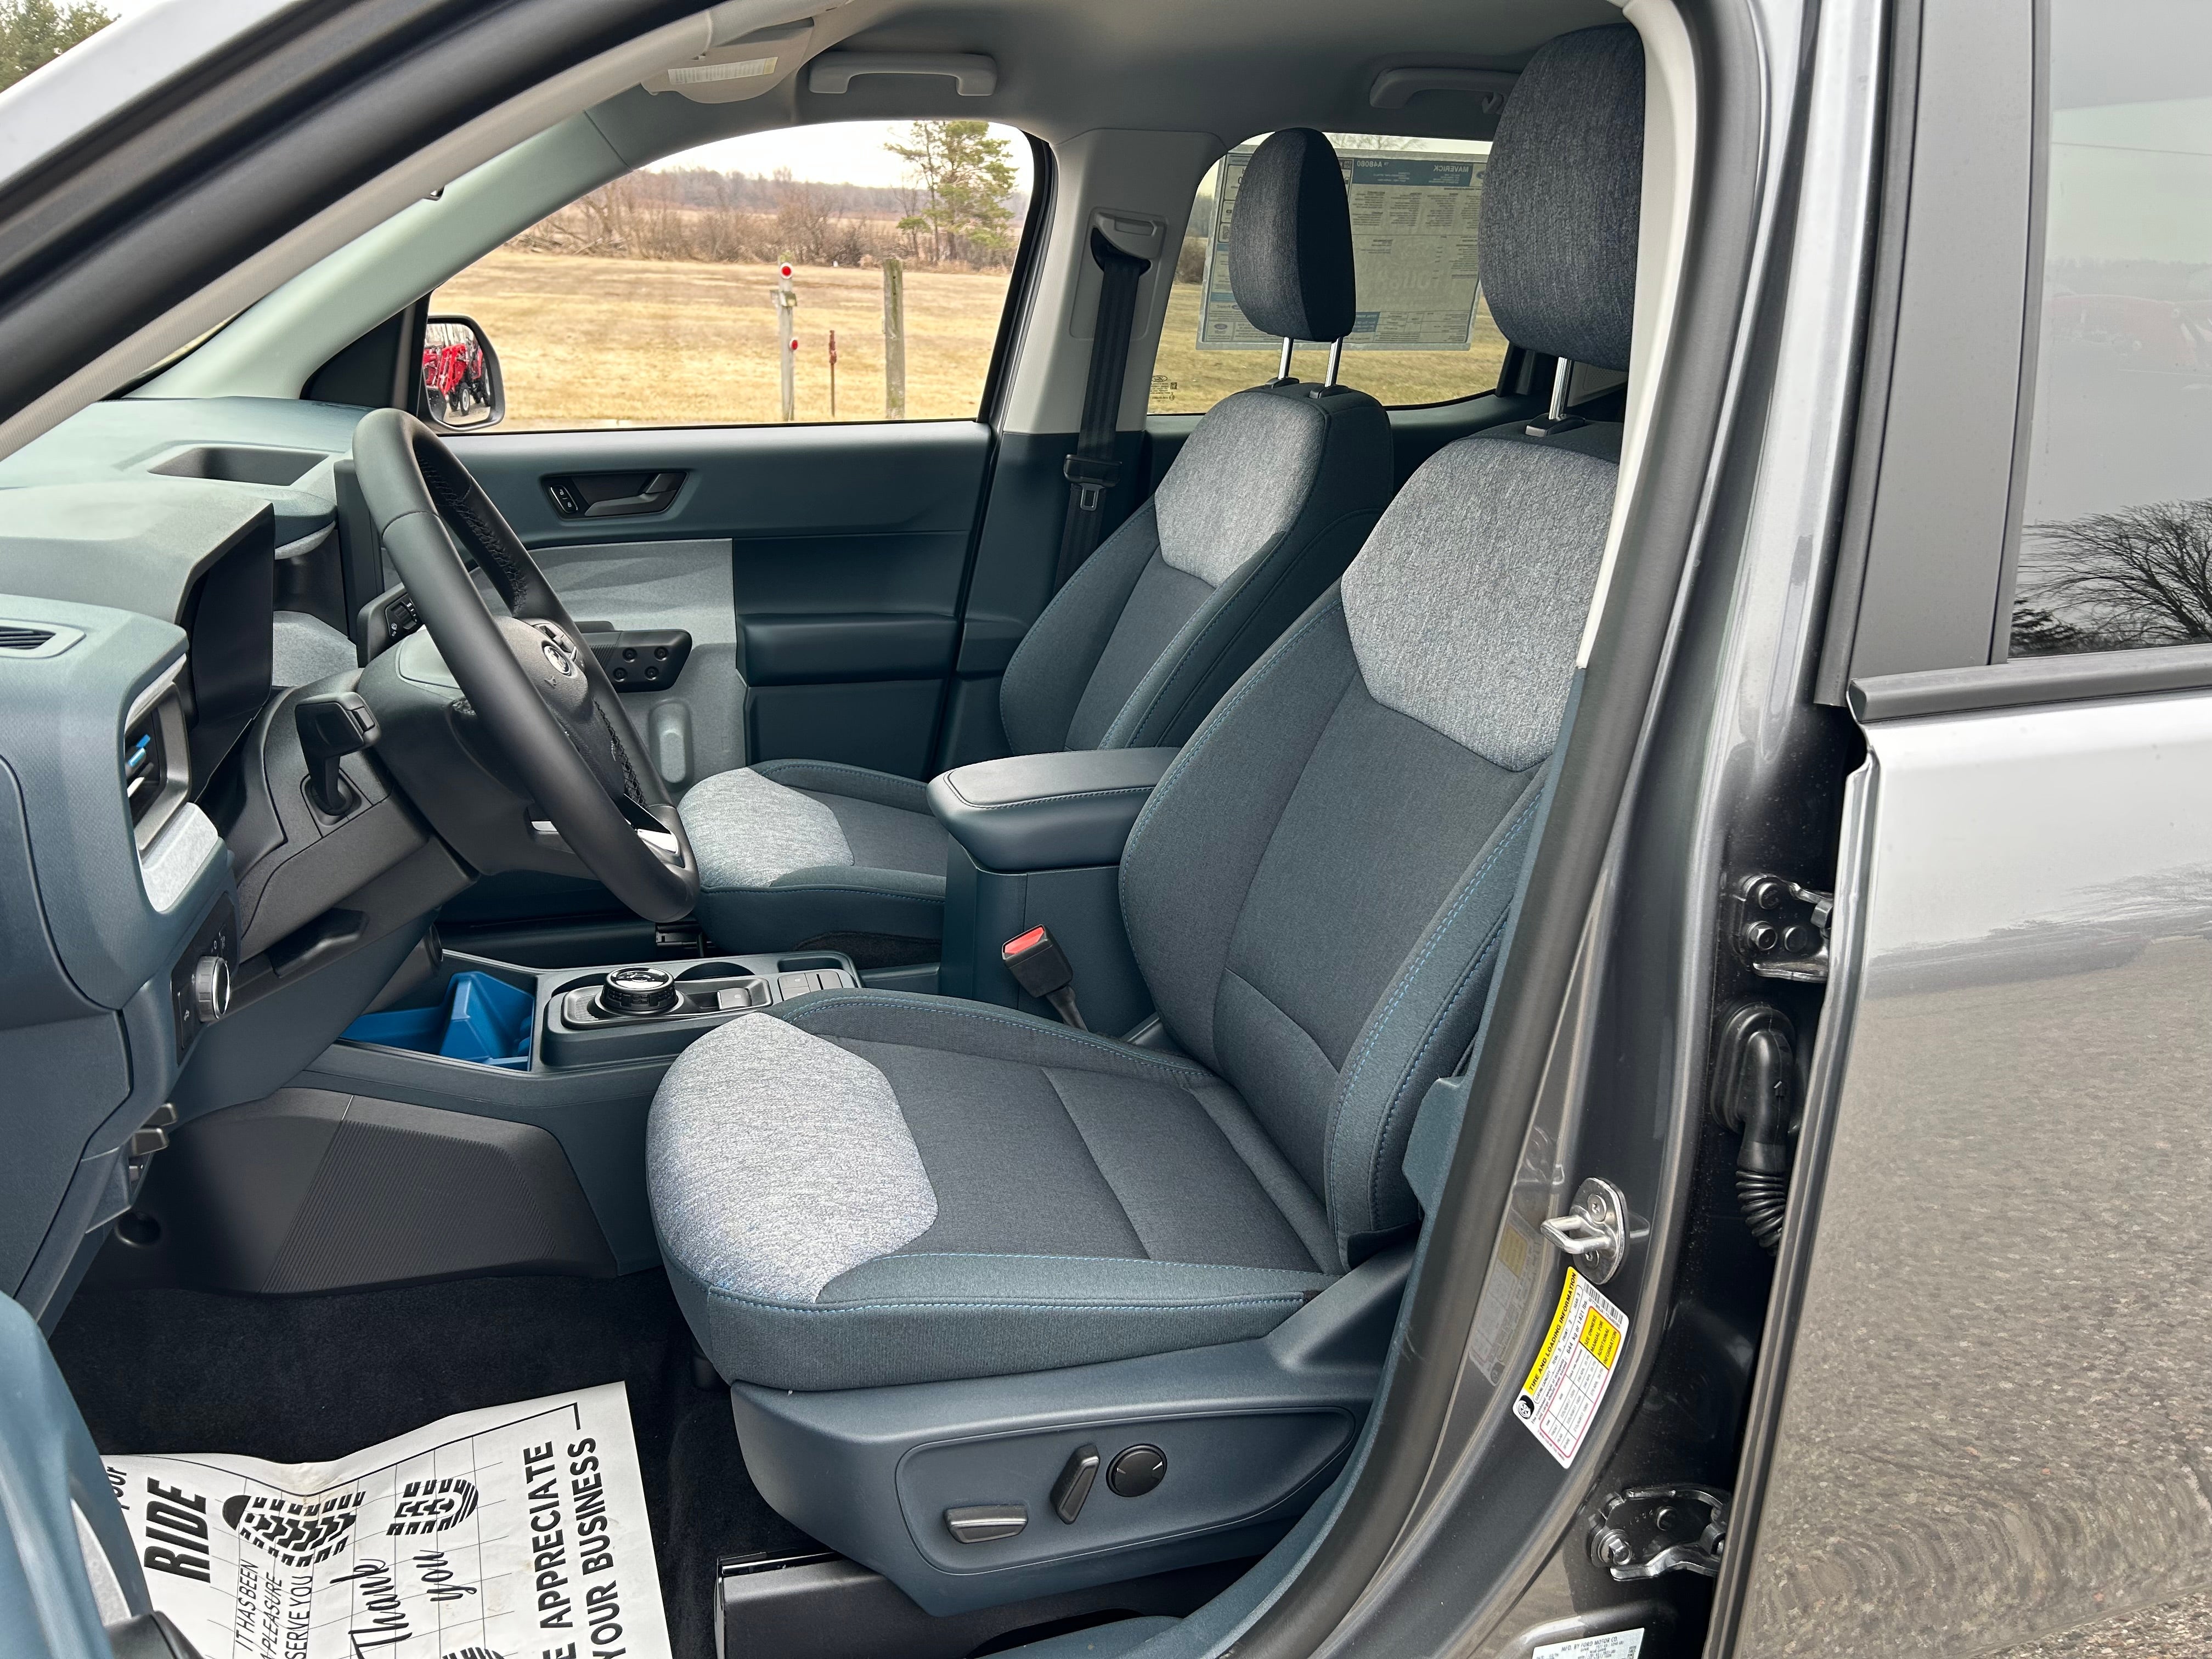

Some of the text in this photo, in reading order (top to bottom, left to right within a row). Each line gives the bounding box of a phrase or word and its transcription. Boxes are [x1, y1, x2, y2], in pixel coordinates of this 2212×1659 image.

[1528, 1272, 1576, 1391] TIRE AND LOADING INFORMATION
[1547, 1386, 1555, 1401] should
[1571, 1332, 1578, 1341] kg
[1576, 1310, 1584, 1324] 1421
[1590, 1331, 1600, 1352] MANUAL
[1597, 1327, 1610, 1357] ADDITIONAL
[1602, 1330, 1617, 1364] INFORMATION
[1544, 1383, 1553, 1397] weight
[107, 1466, 130, 1510] our
[567, 1437, 614, 1576] BUSINESS
[144, 1477, 211, 1584] RIDE
[523, 1441, 573, 1629] APPRECIATE
[235, 1559, 258, 1651] IT HAS BEEN
[262, 1572, 282, 1655] PLEASURE
[285, 1576, 312, 1659] SERVE YOU
[330, 1559, 412, 1659] Thank
[413, 1550, 477, 1602] you
